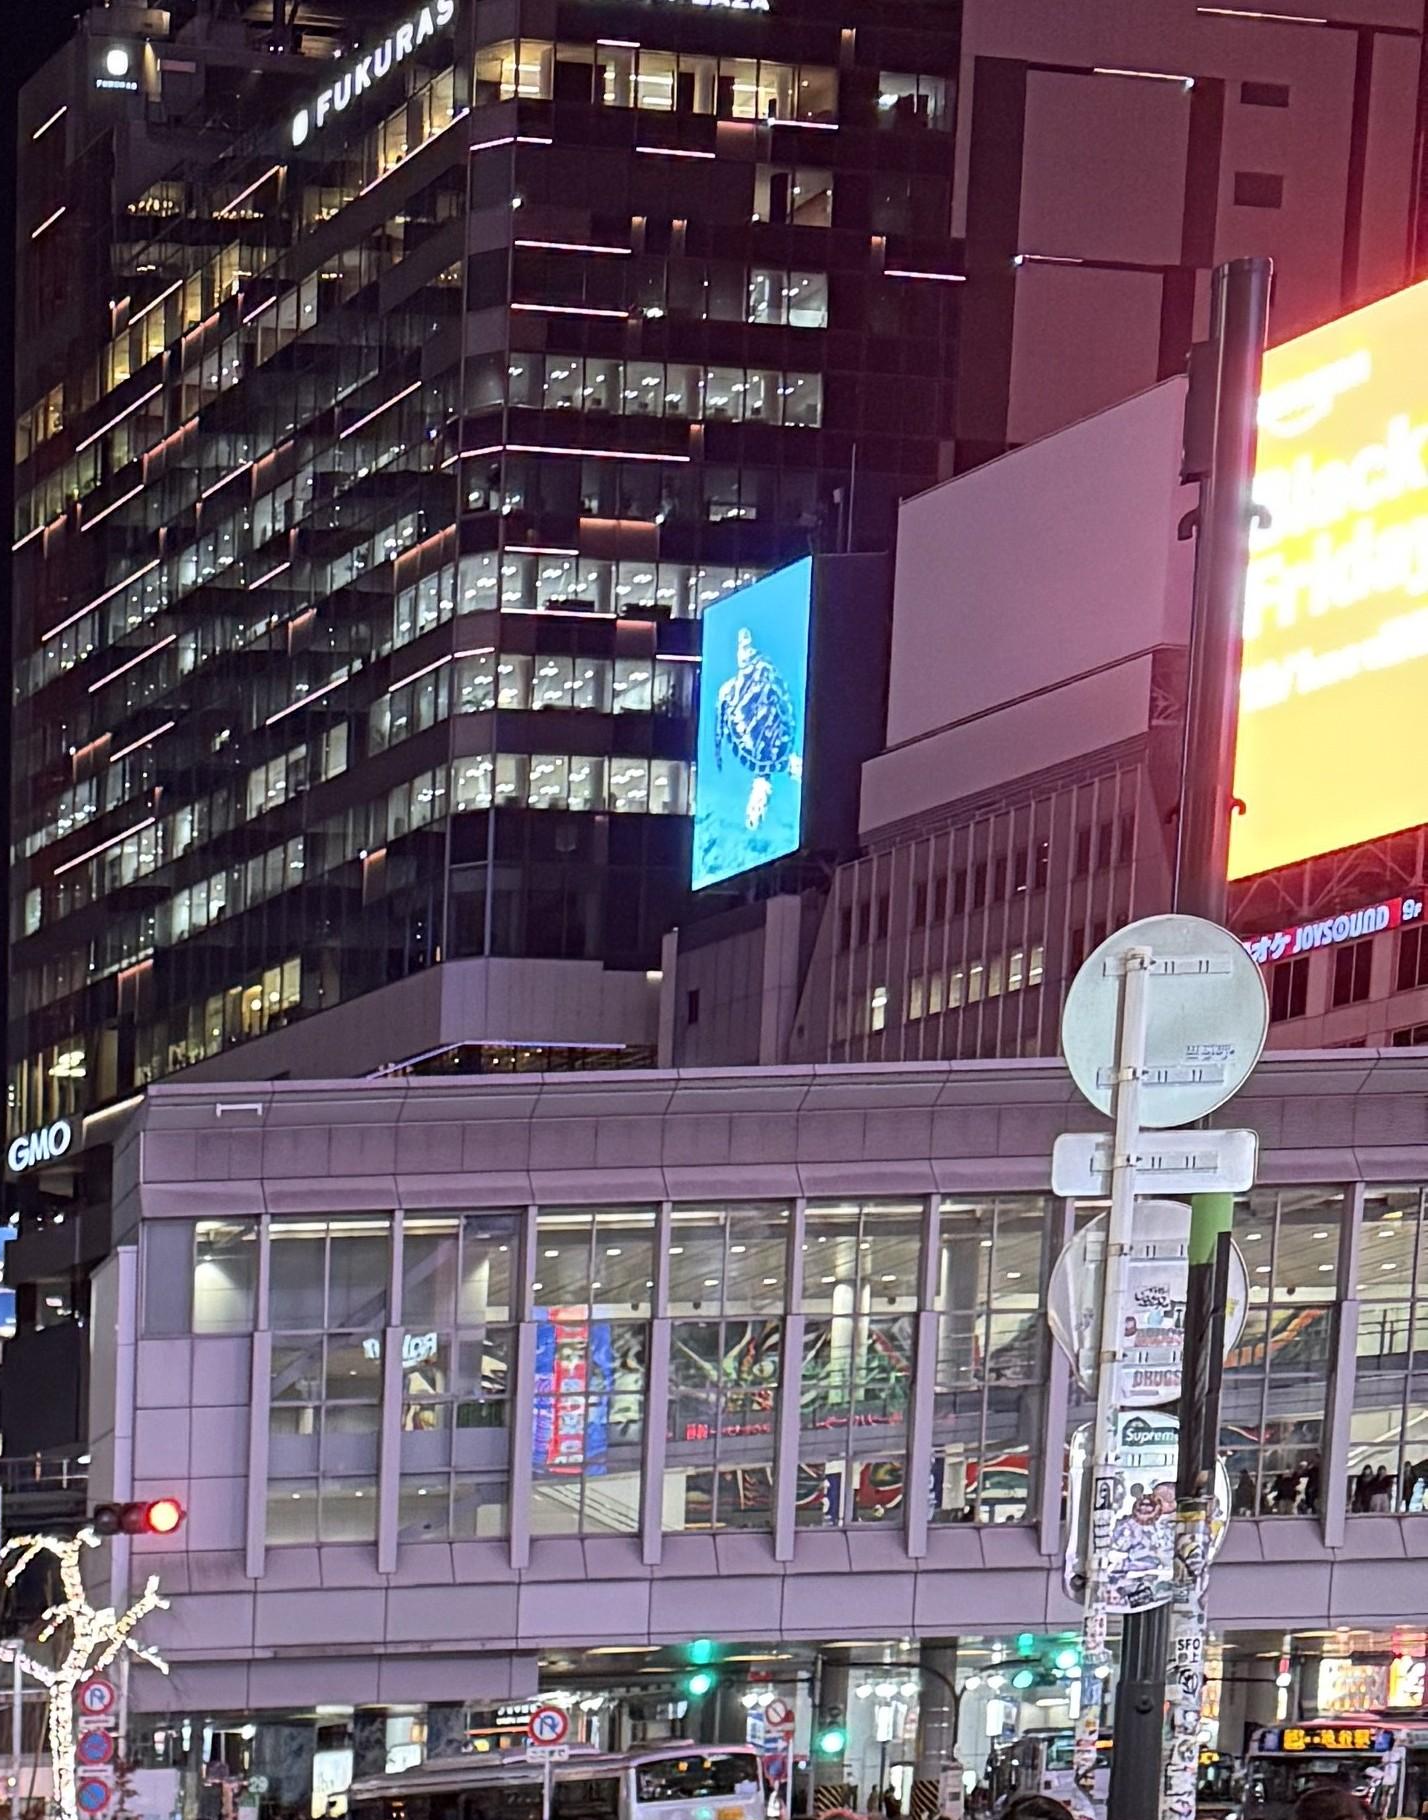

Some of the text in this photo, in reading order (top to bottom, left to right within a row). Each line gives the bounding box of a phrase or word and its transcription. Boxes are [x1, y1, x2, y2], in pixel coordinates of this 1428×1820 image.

[316, 0, 454, 127] FUKURAS
[1293, 905, 1390, 953] JOYSOUND
[8, 1120, 71, 1172] GMO
[1178, 1638, 1200, 1651] SFO
